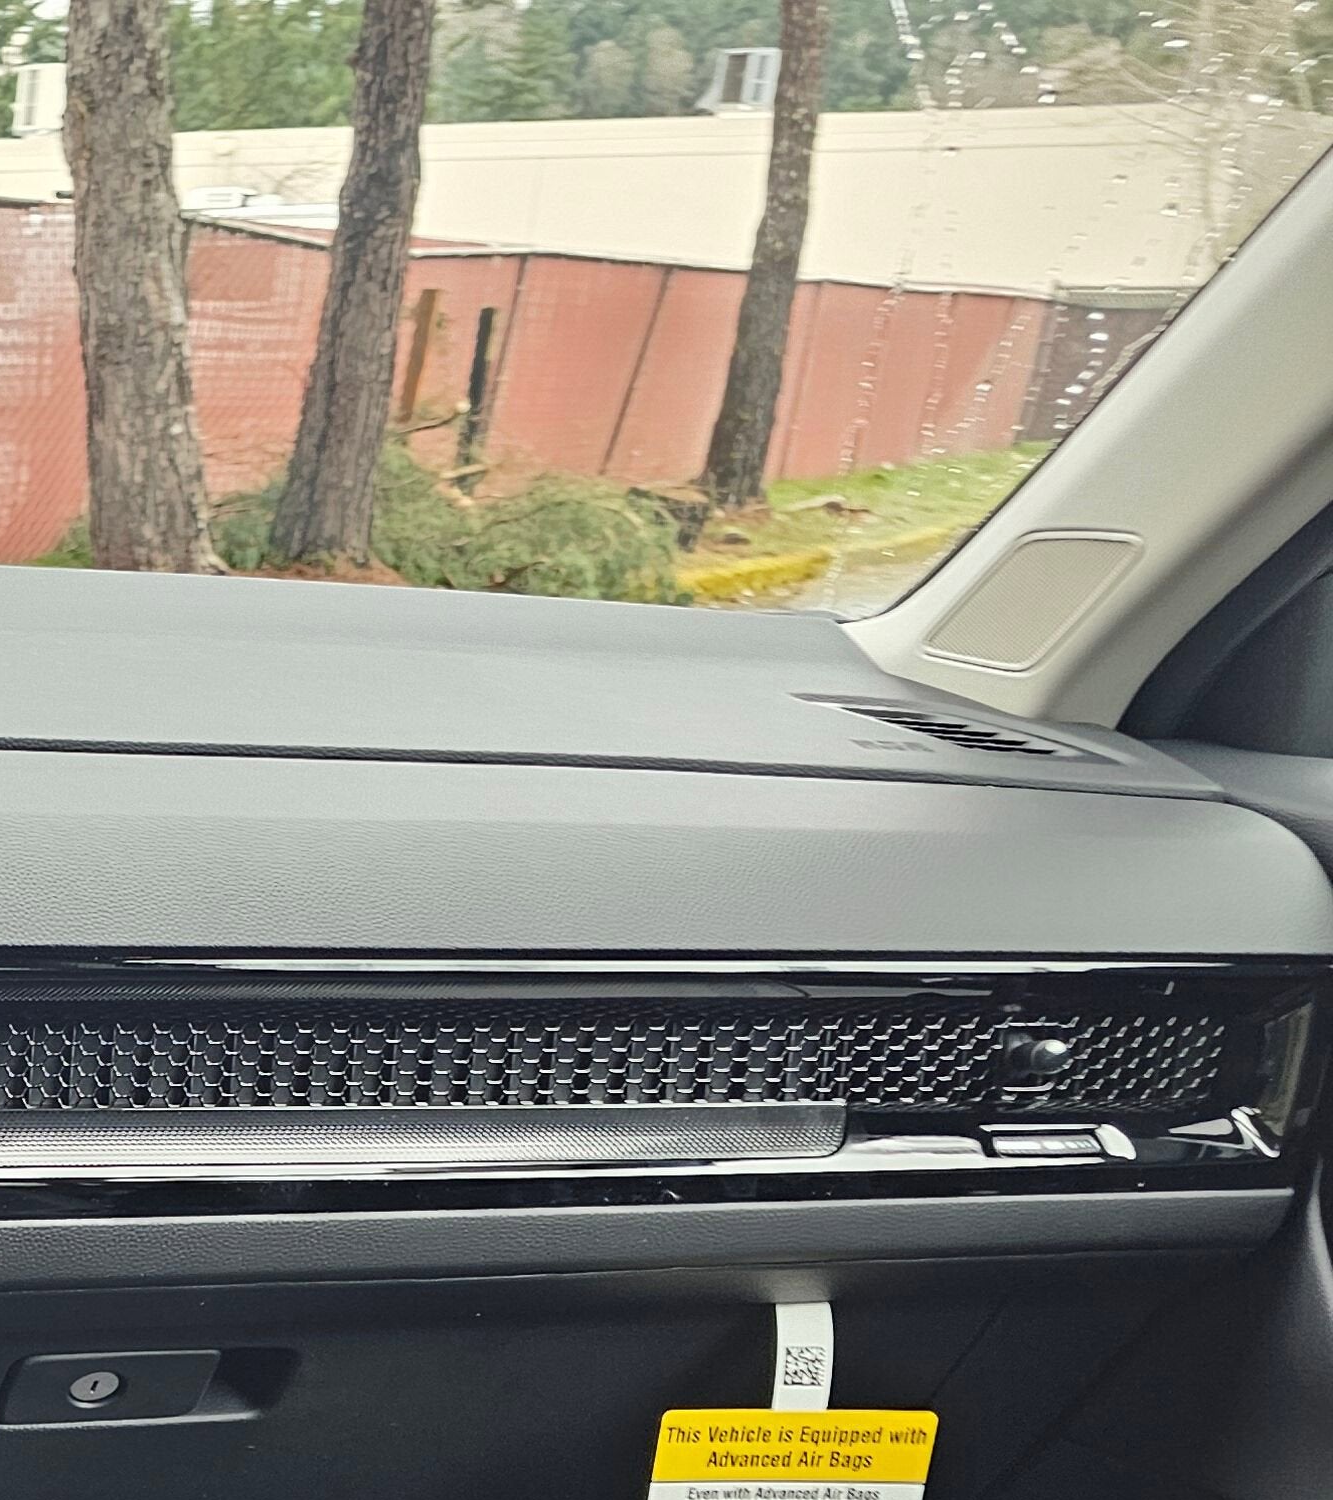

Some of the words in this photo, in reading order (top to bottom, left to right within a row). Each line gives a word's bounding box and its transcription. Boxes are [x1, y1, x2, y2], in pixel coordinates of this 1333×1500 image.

[667, 1426, 701, 1444] This
[707, 1426, 771, 1443] Vehicle
[778, 1427, 793, 1443] is
[799, 1426, 882, 1447] Equipped
[889, 1428, 927, 1445] with
[706, 1451, 792, 1468] Advanced
[797, 1452, 823, 1468] Air
[828, 1452, 873, 1472] Bags
[688, 1487, 719, 1500] Even
[723, 1487, 750, 1500] with
[756, 1487, 819, 1500] Advanced
[823, 1487, 843, 1500] Air
